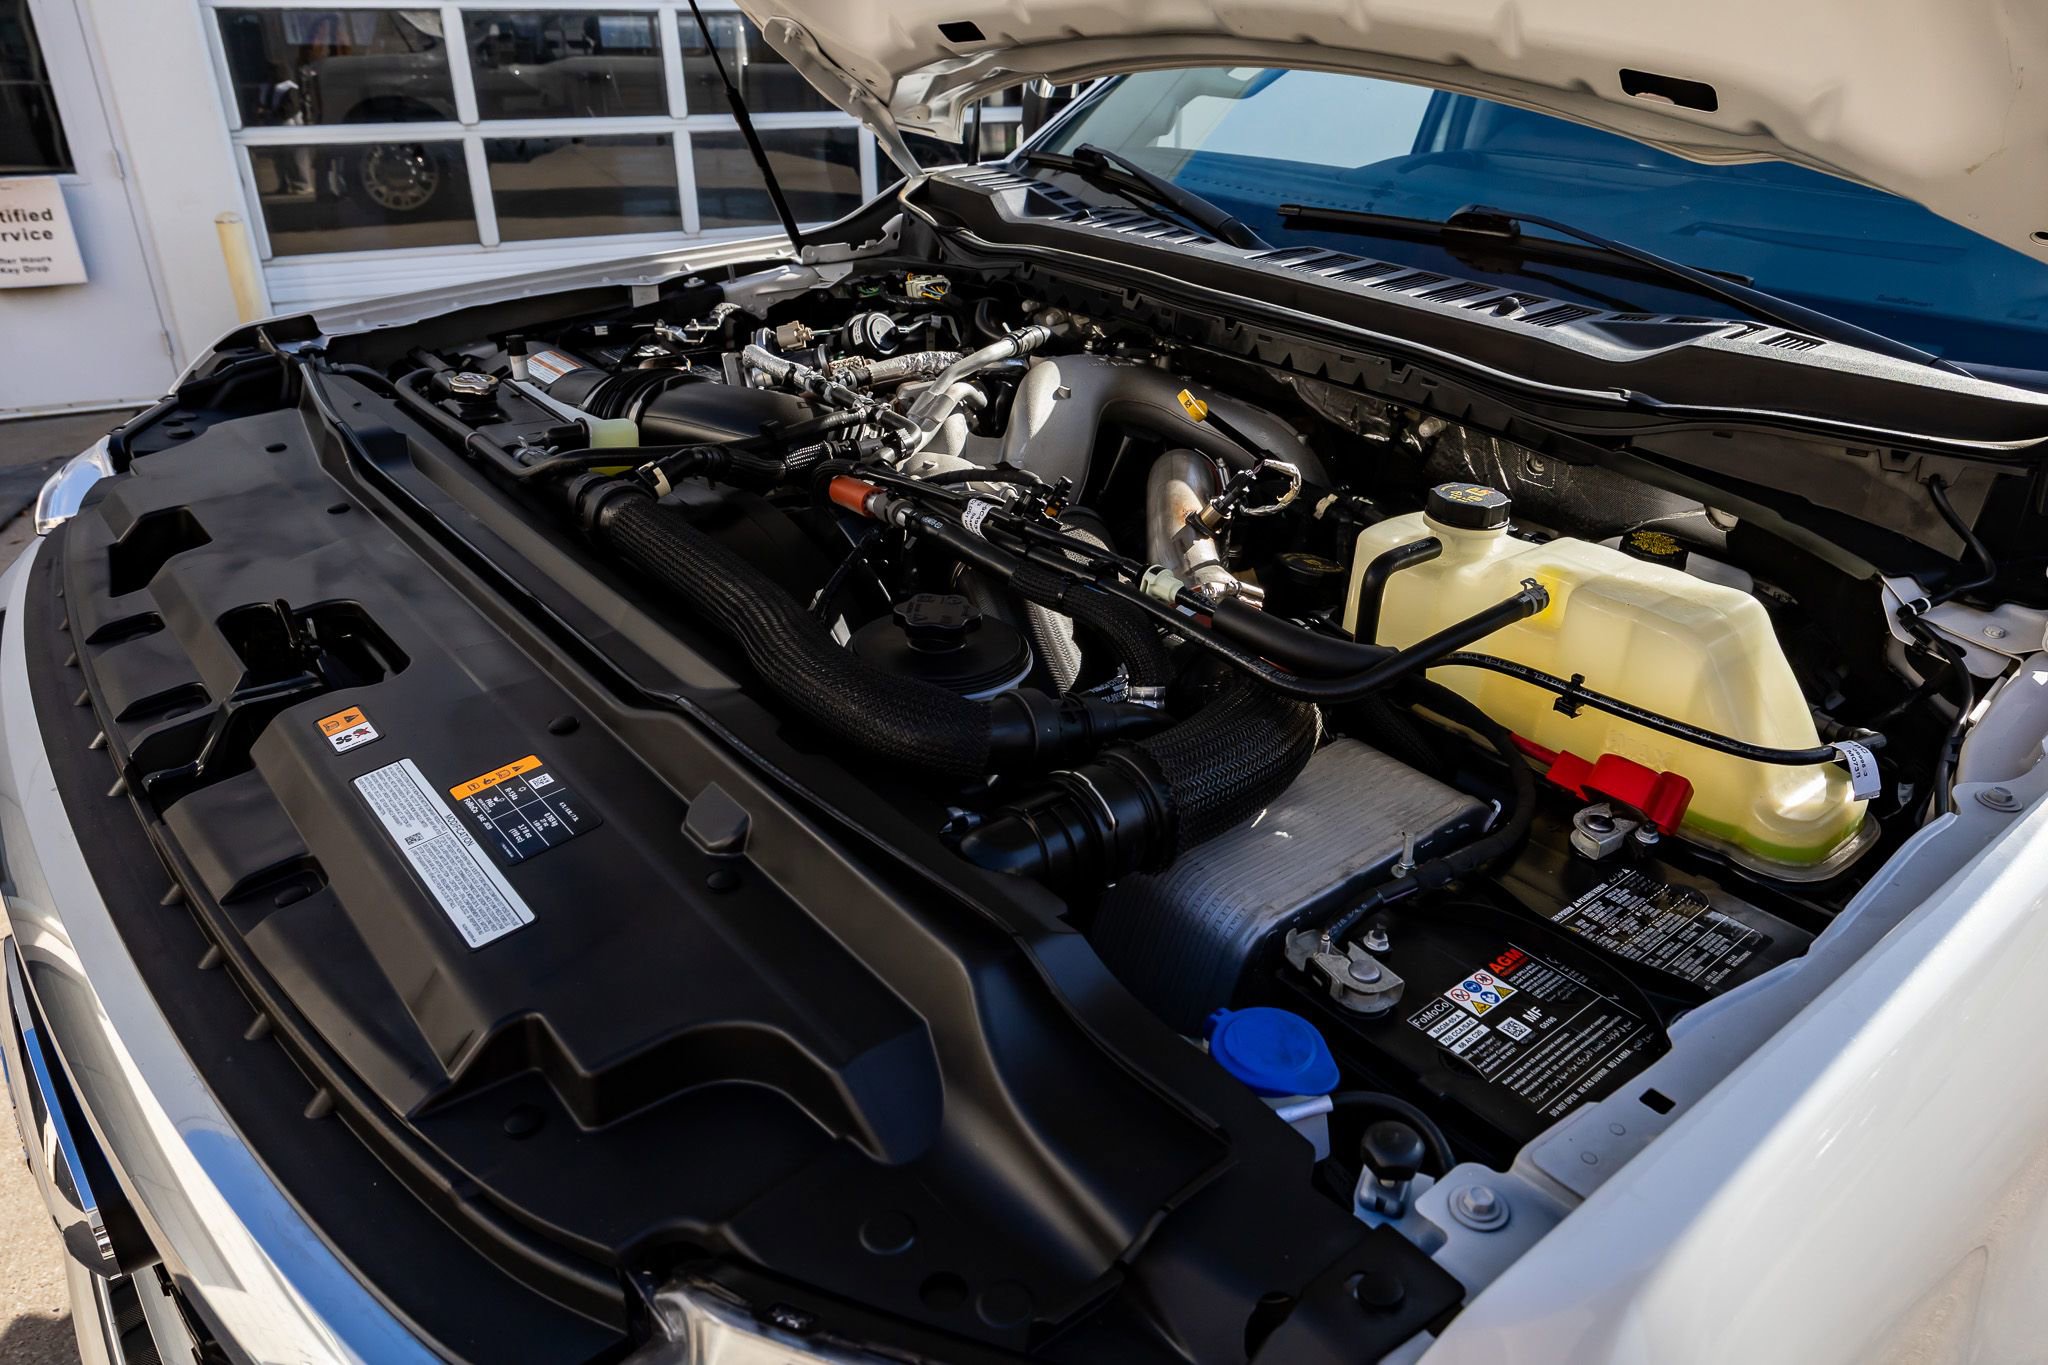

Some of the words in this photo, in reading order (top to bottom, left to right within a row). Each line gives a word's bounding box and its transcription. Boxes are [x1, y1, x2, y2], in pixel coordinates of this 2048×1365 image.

[0, 208, 54, 223] tified
[1, 228, 54, 242] rvice
[443, 813, 475, 847] MODIFICATION
[1486, 946, 1523, 974] AGM
[1411, 999, 1450, 1028] FoMoCo
[1521, 1005, 1545, 1023] MF
[1441, 1034, 1453, 1043] 750
[1463, 1035, 1474, 1043] Ah
[1548, 1108, 1560, 1117] DO
[1555, 1101, 1568, 1111] NOT
[1582, 1079, 1594, 1089] PAS
